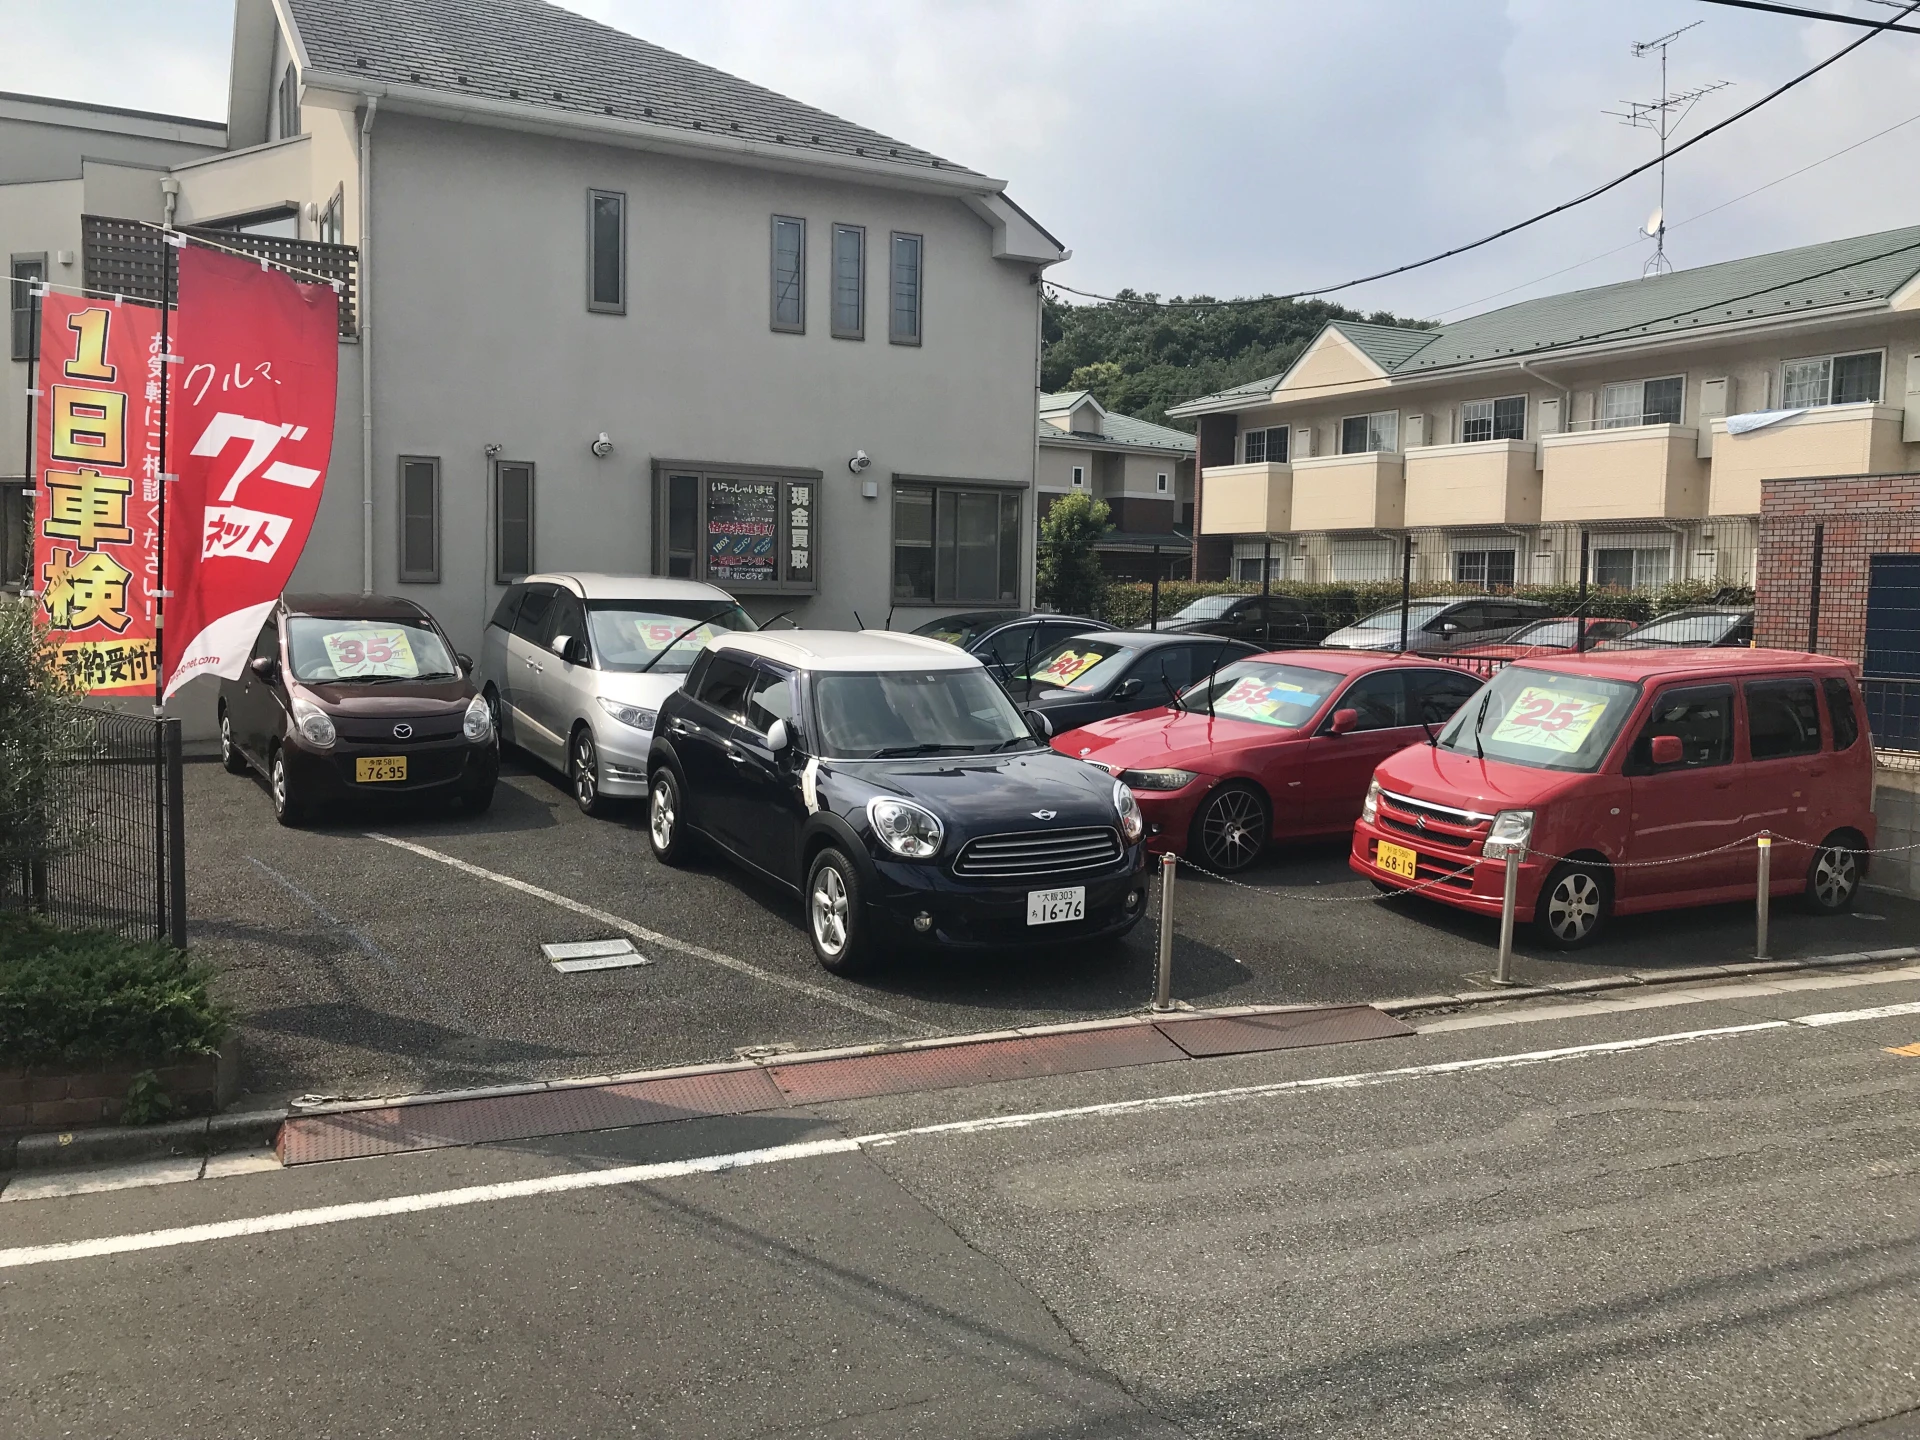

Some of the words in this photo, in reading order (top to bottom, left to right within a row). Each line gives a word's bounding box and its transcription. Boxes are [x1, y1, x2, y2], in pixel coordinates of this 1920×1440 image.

[42, 307, 134, 634] 1日車検
[190, 411, 322, 502] グー
[711, 482, 774, 494] いらっしゃいませ
[205, 513, 275, 553] ネット
[791, 486, 809, 569] 現金買取
[367, 766, 404, 780] 76-95
[1385, 855, 1413, 875] 68-19
[1042, 900, 1083, 922] 16-76
